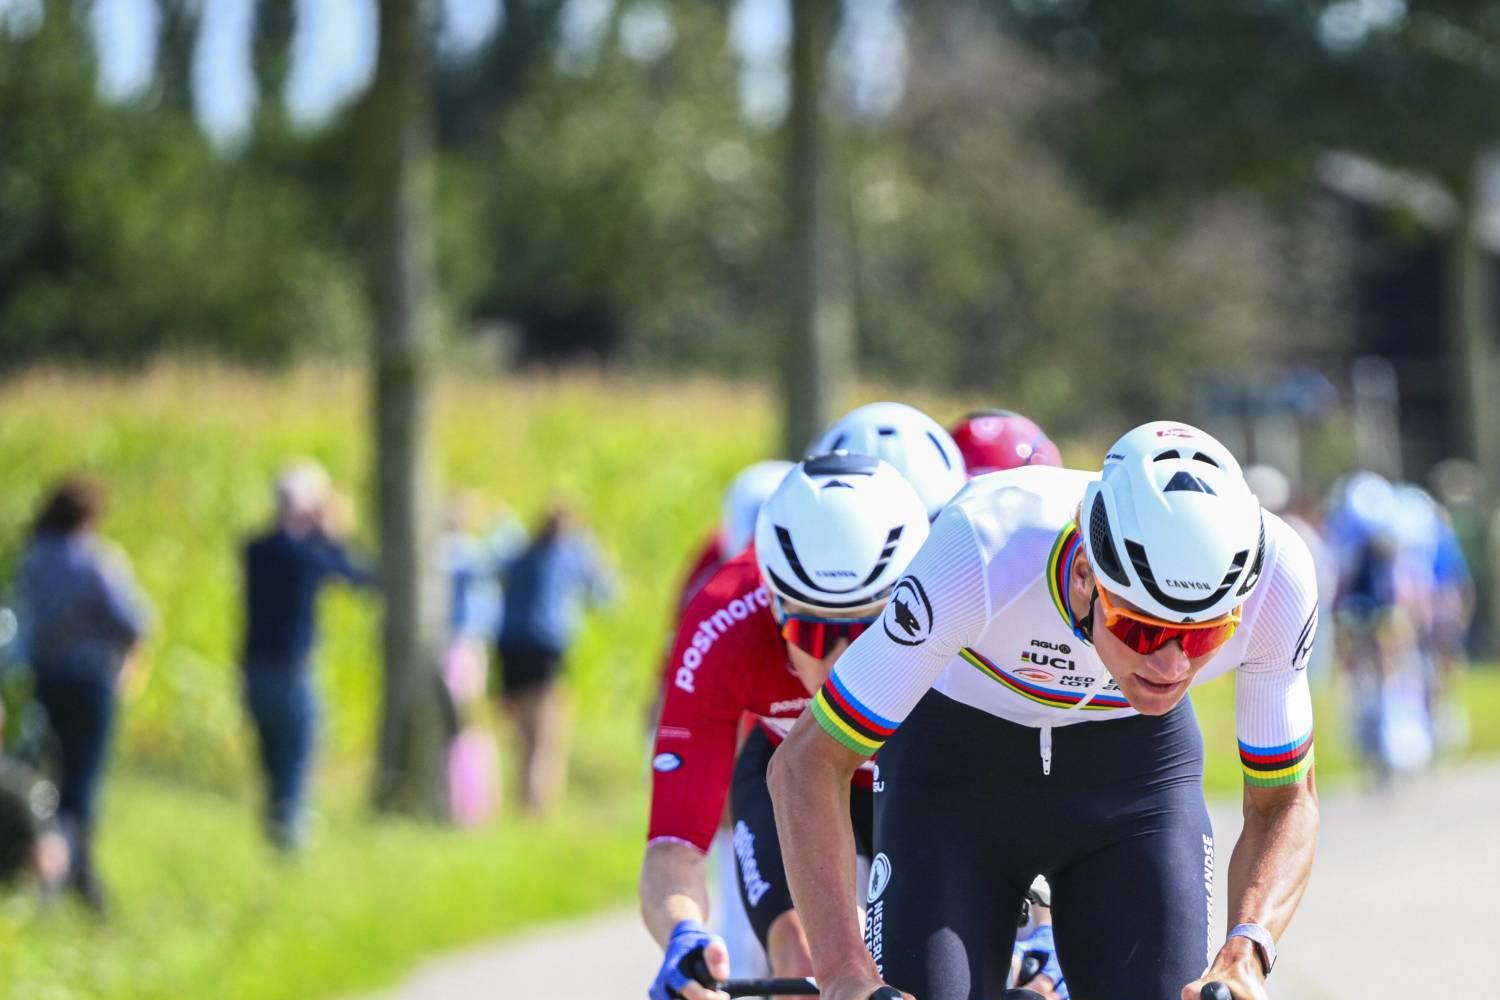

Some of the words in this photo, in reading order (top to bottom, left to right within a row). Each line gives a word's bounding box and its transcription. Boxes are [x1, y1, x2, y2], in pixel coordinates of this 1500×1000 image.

[1165, 579, 1211, 591] CANYON
[1031, 639, 1058, 651] AGU
[1030, 653, 1075, 671] UCI
[873, 782, 885, 793] GU
[865, 907, 873, 953] LOTE
[873, 900, 884, 978] NEDERLA
